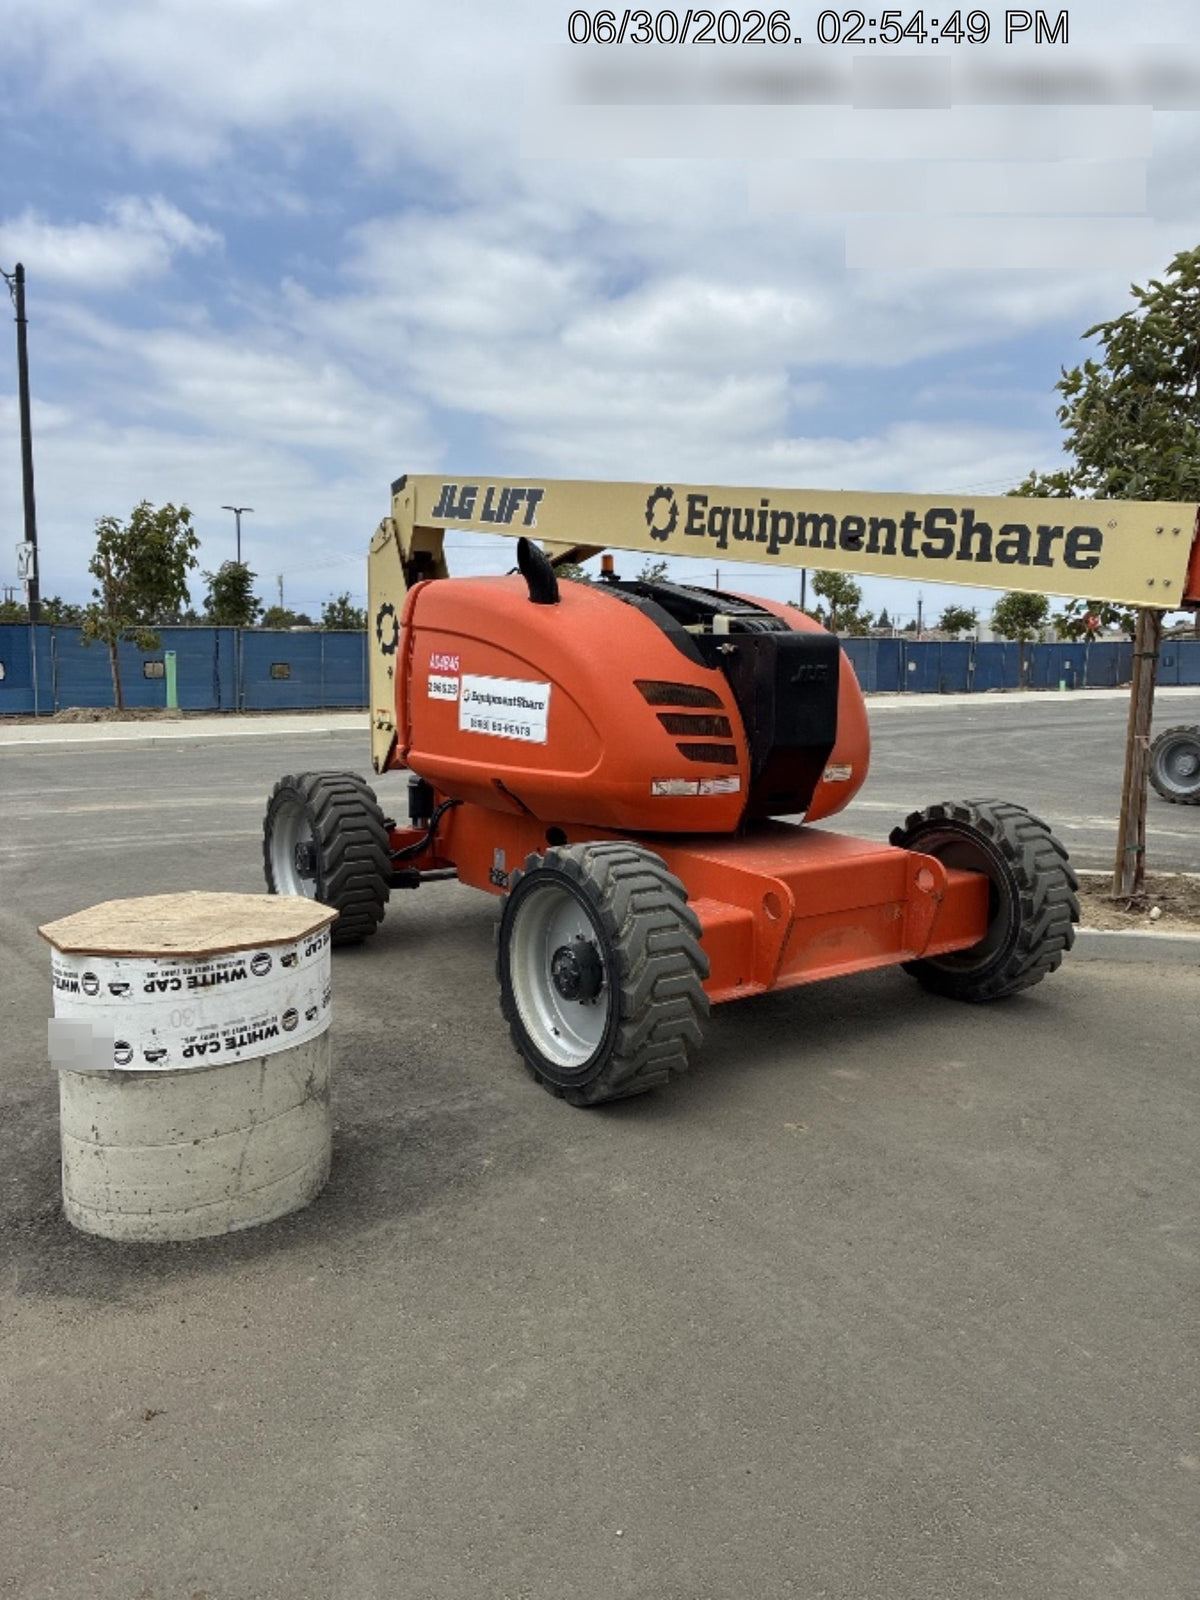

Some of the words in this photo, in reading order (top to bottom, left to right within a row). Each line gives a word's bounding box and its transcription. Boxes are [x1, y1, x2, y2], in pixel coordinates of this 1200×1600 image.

[431, 483, 479, 520] JLG
[480, 486, 545, 526] LIFT
[684, 494, 1104, 570] EquipmentShare
[471, 691, 545, 710] EquipmentShare
[143, 978, 182, 993] CAP
[186, 967, 248, 990] WHITE
[225, 1024, 280, 1050] WHITE
[181, 1041, 221, 1059] CAP
